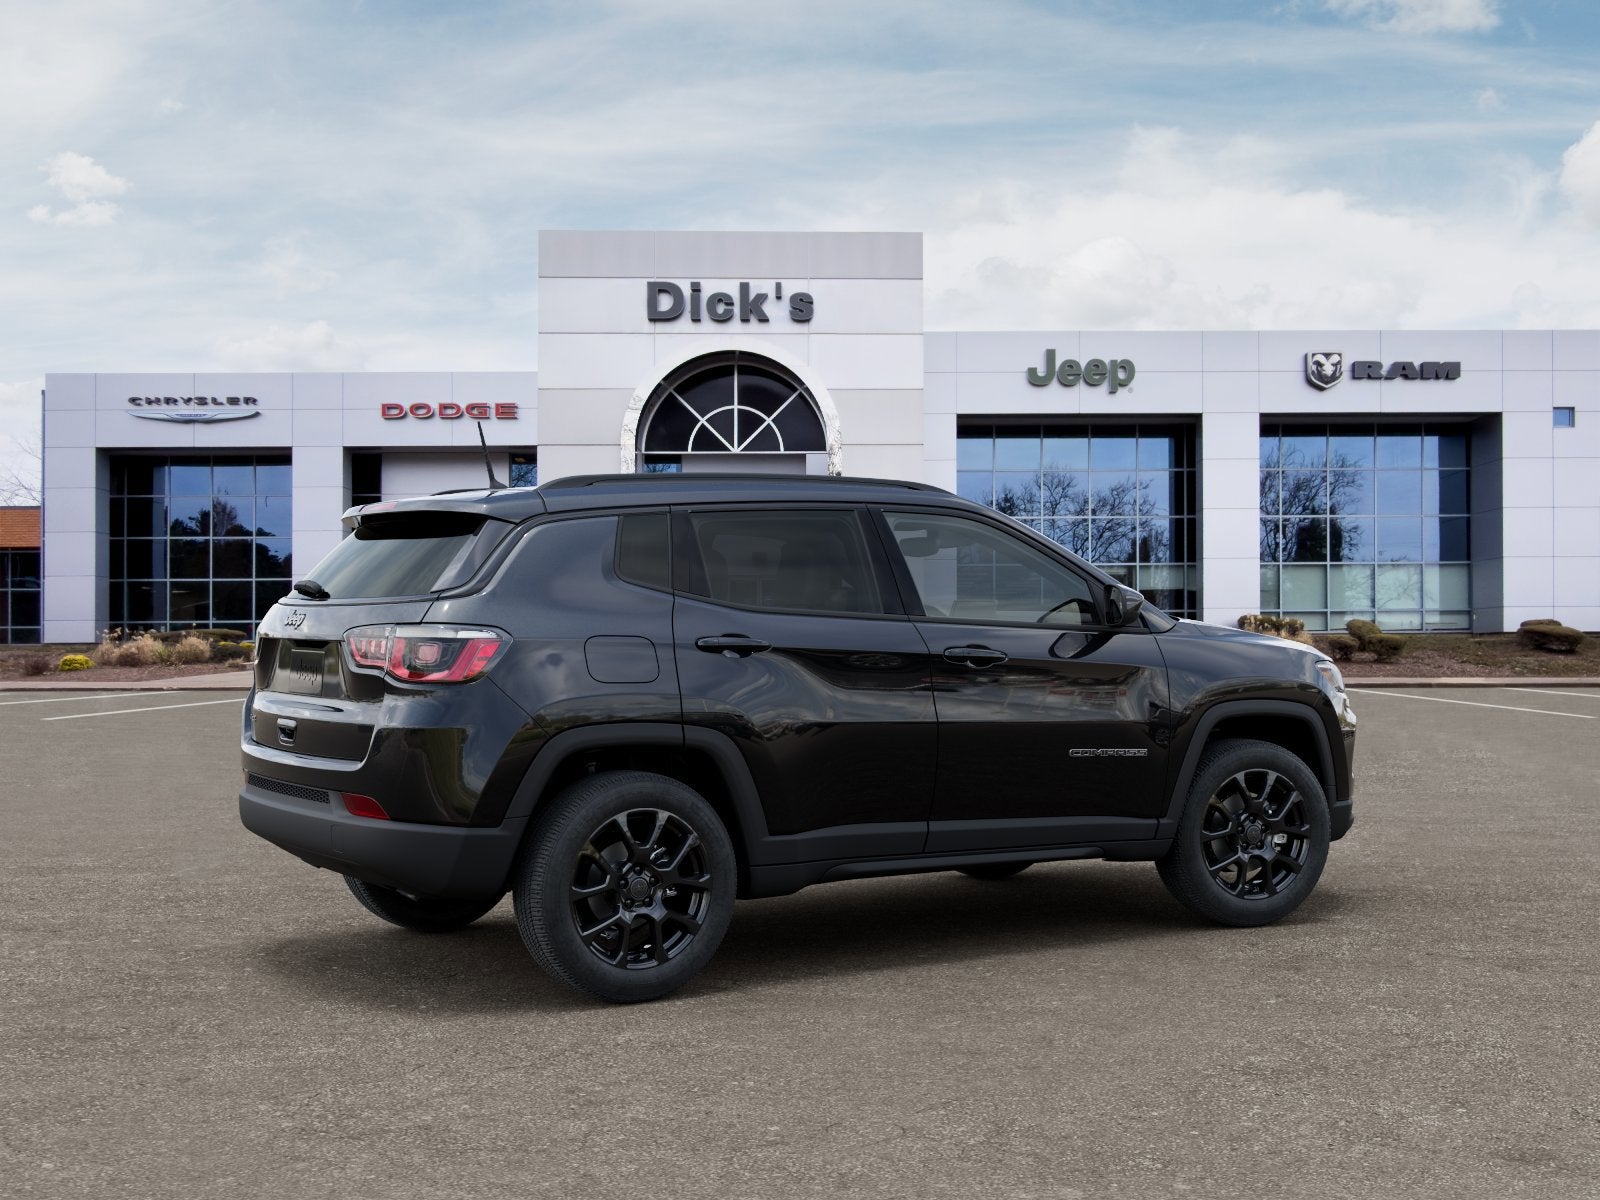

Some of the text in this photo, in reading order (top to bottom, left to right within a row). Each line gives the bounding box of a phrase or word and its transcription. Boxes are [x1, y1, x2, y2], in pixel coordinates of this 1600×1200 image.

[647, 281, 814, 322] Dick's
[1026, 348, 1136, 394] Jeep
[1352, 360, 1461, 380] RAM
[128, 396, 258, 407] CHRYSLER
[381, 402, 519, 420] DODGE
[1069, 748, 1148, 757] COMPASS
